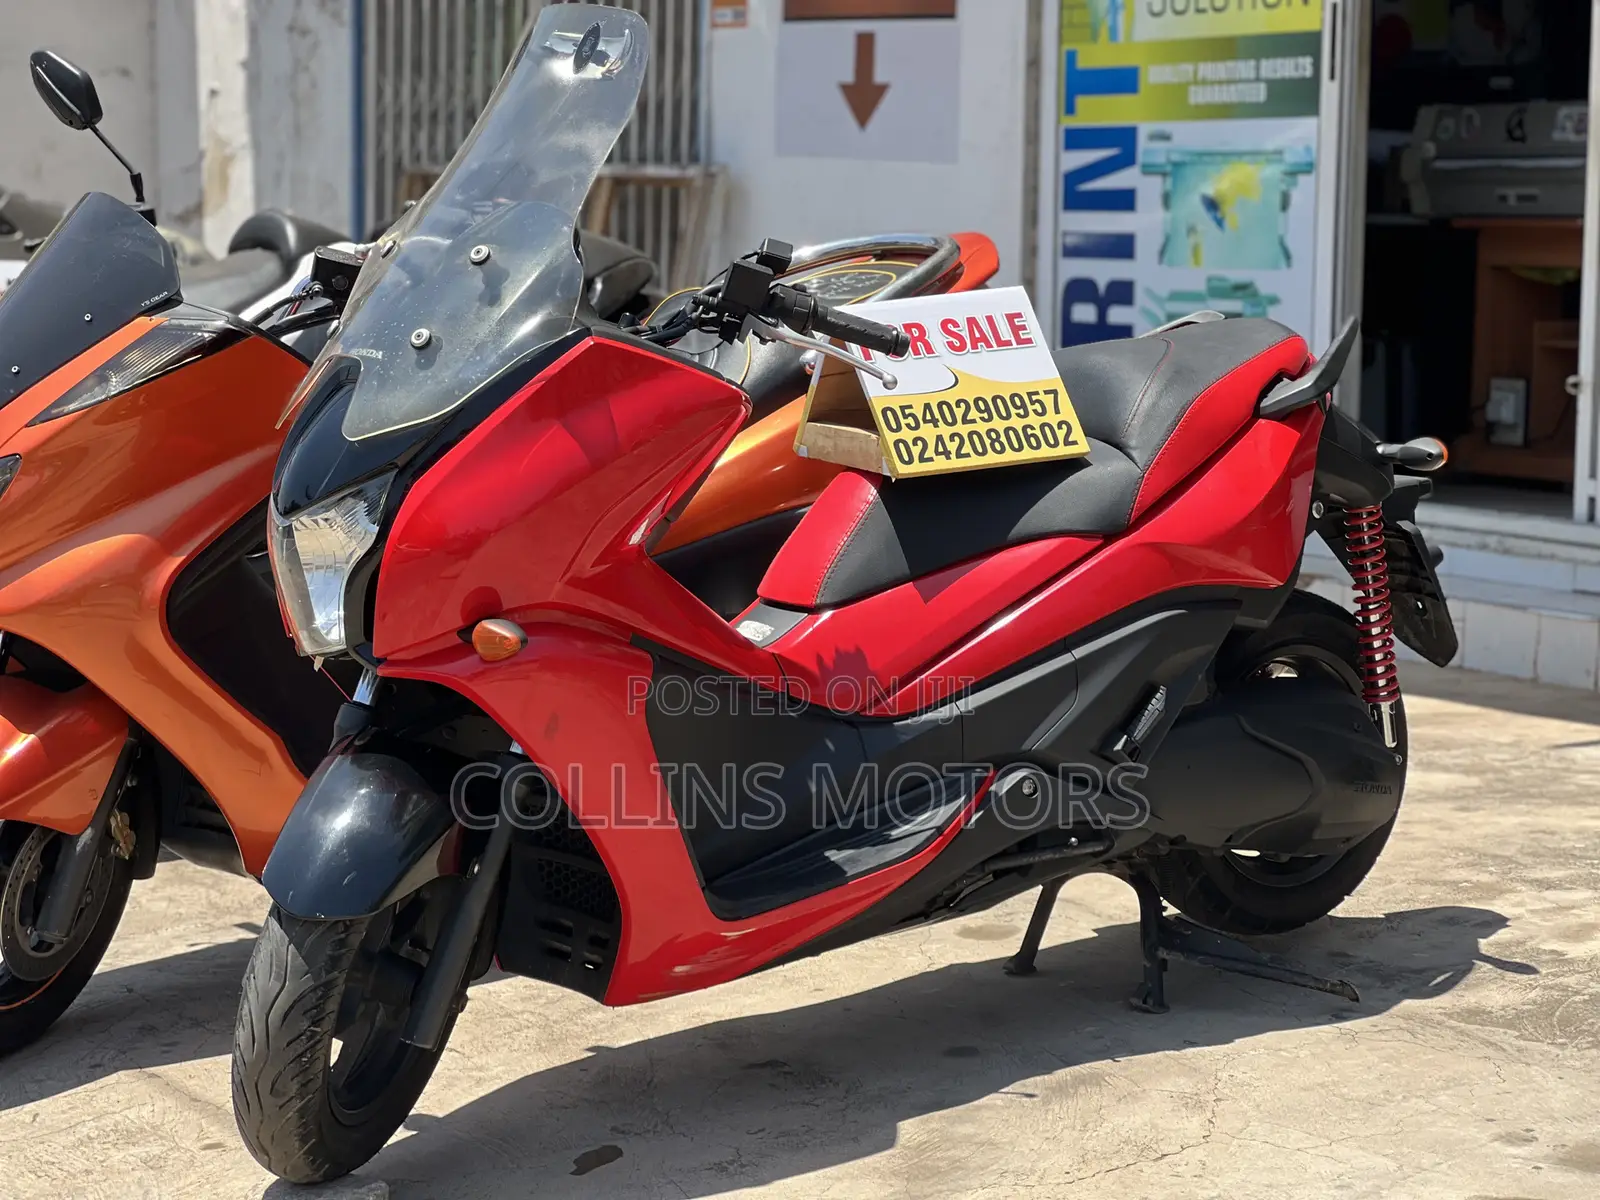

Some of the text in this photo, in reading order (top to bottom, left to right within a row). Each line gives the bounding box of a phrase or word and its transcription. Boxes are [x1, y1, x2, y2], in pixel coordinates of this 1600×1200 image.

[1197, 59, 1257, 81] PRINTING
[1260, 55, 1313, 79] RESULTS
[1061, 49, 1139, 349] RINT
[939, 311, 1036, 355] SALE
[881, 388, 1062, 434] 0540290957
[893, 420, 1078, 466] 0242080602
